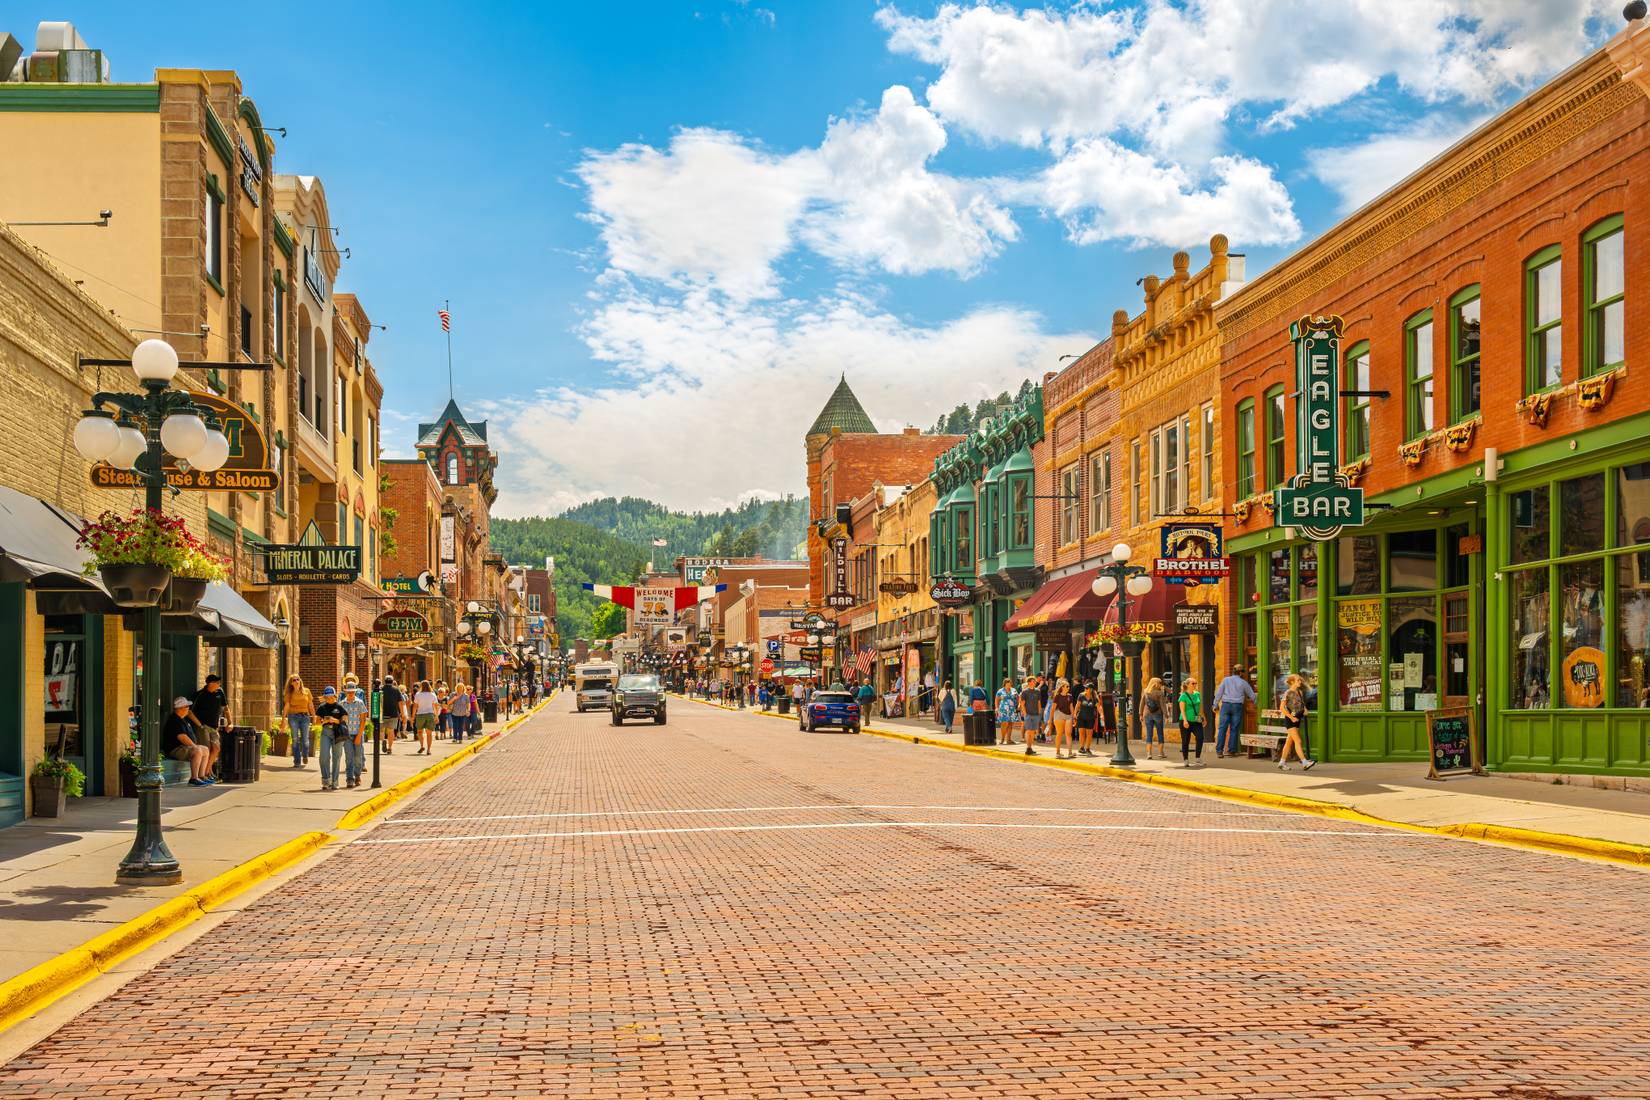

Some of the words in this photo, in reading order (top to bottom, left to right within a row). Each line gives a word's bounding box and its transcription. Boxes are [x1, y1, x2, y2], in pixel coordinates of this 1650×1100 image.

[1311, 354, 1330, 483] EAGLE
[99, 469, 193, 487] Steause
[197, 472, 211, 487] &
[215, 471, 271, 487] Saloon
[1293, 496, 1352, 518] BAR
[269, 550, 314, 570] MINERAL
[318, 549, 357, 570] PALACE
[1156, 558, 1230, 571] BROTHEL
[386, 582, 411, 591] HOTEL
[636, 589, 674, 598] WELCOME
[931, 588, 952, 599] Sick
[953, 588, 970, 599] Boy
[830, 597, 853, 606] BAR
[388, 617, 424, 631] GEM
[1176, 616, 1215, 625] BROTHEL
